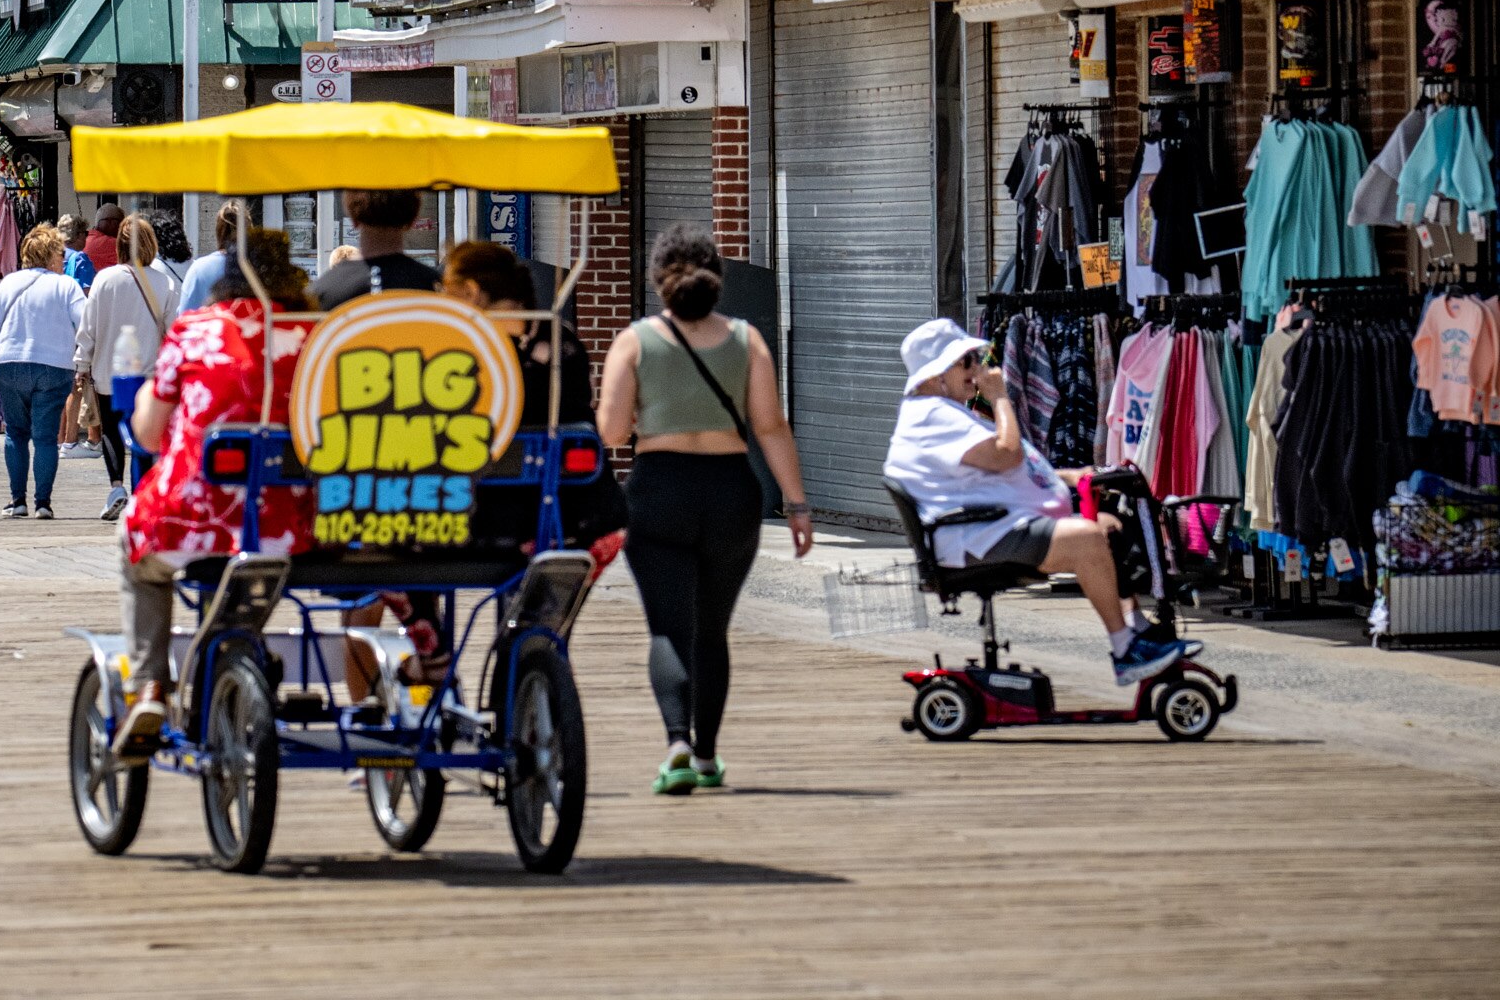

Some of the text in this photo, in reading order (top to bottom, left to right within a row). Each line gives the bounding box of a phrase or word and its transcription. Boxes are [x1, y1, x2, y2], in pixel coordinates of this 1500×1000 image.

[338, 349, 478, 412] BIG
[308, 413, 492, 474] JIM'S
[318, 474, 473, 513] BIKES
